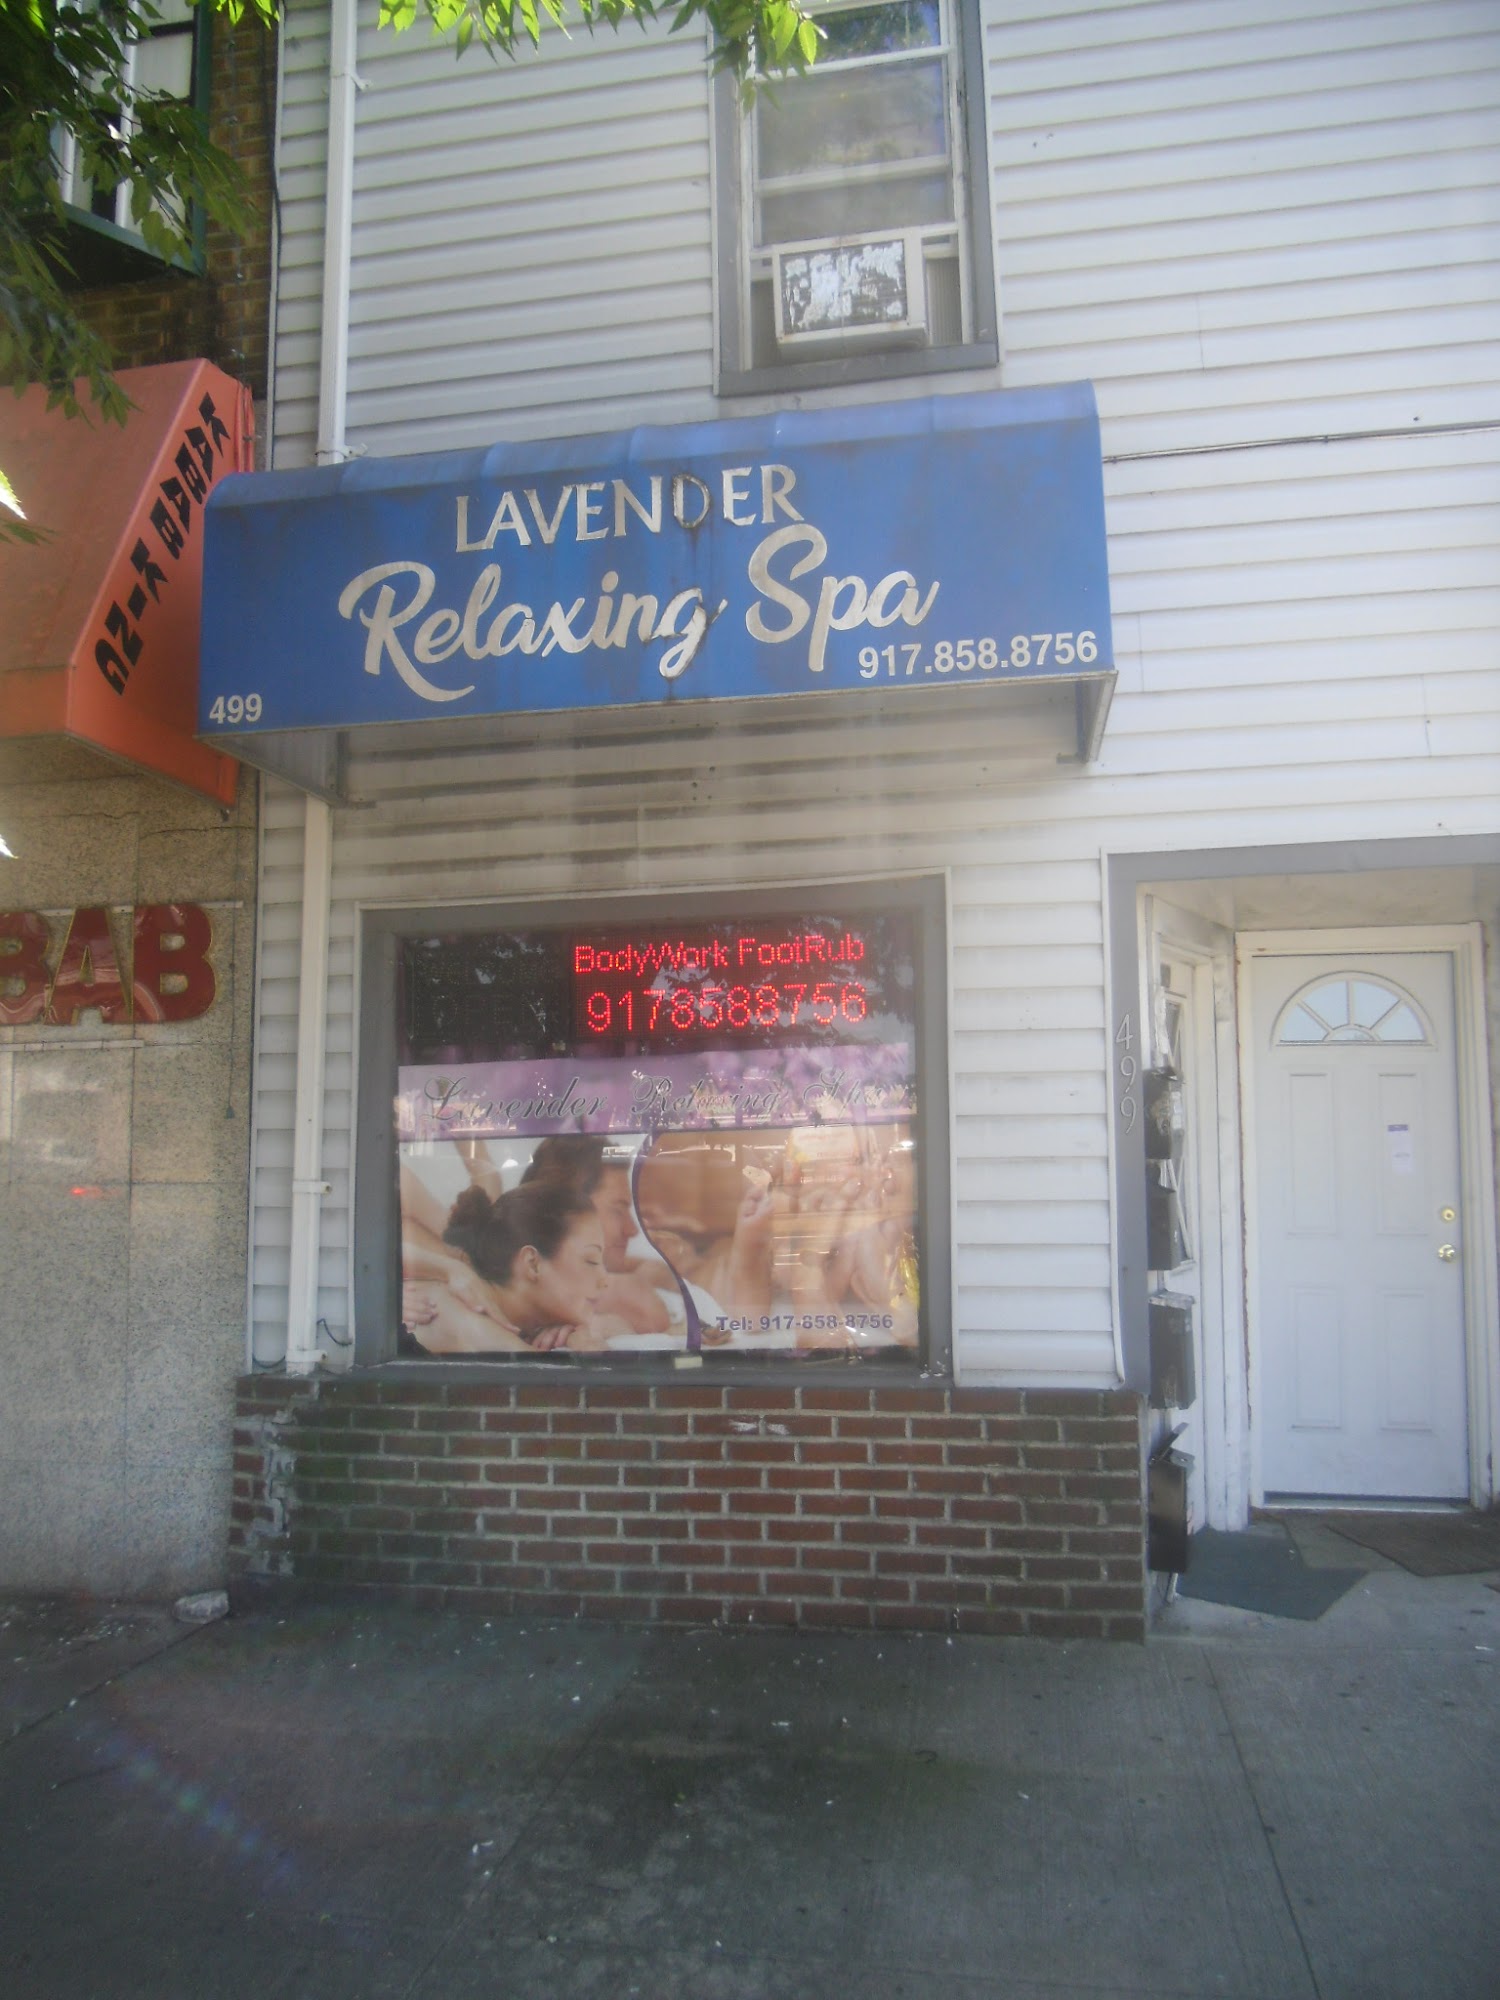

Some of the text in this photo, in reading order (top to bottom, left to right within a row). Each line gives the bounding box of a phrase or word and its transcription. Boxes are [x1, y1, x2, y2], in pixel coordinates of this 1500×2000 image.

[456, 463, 805, 552] LAVENDER
[95, 391, 231, 696] KABAB KING
[338, 523, 940, 701] Relaxing Spa
[858, 630, 1098, 679] 917.858.8756
[209, 693, 262, 724] 499
[574, 940, 728, 977] BodyWork
[738, 933, 865, 967] FootRub
[587, 981, 866, 1033] 9178588756
[1116, 1013, 1136, 1134] 499
[716, 1304, 893, 1331] Tel: 917-858-8756
